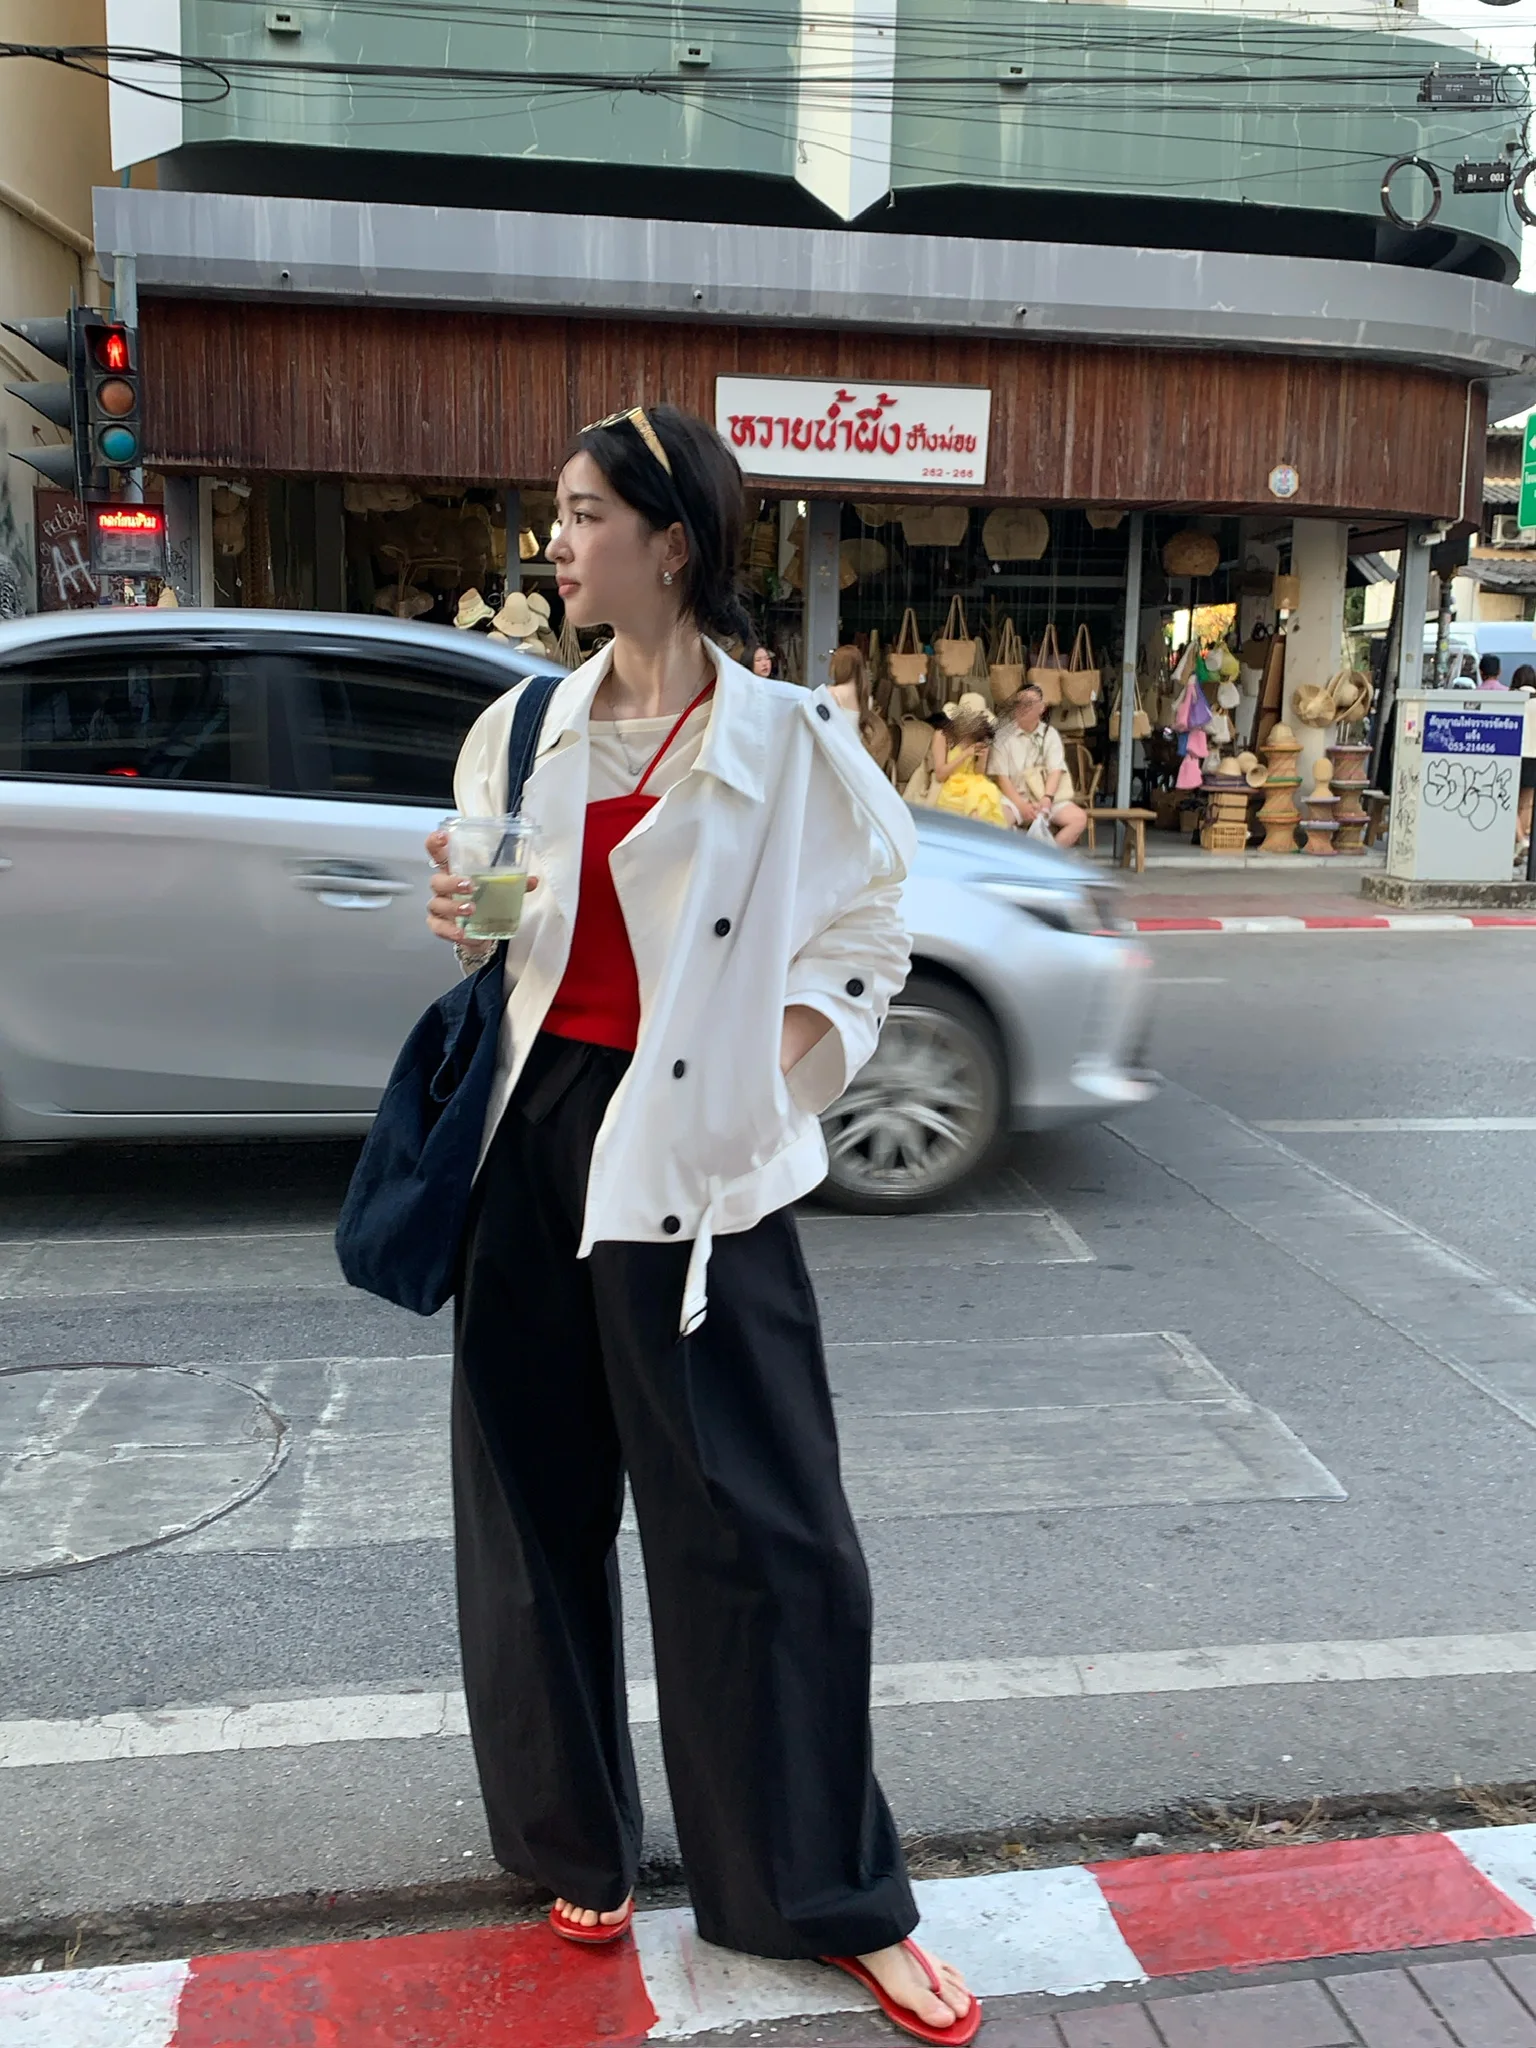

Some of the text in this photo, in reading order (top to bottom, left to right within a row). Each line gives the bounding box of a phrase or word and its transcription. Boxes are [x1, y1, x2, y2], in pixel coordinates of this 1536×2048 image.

[727, 389, 977, 455] หวายน้ำผึ้ง ช้างม่อย
